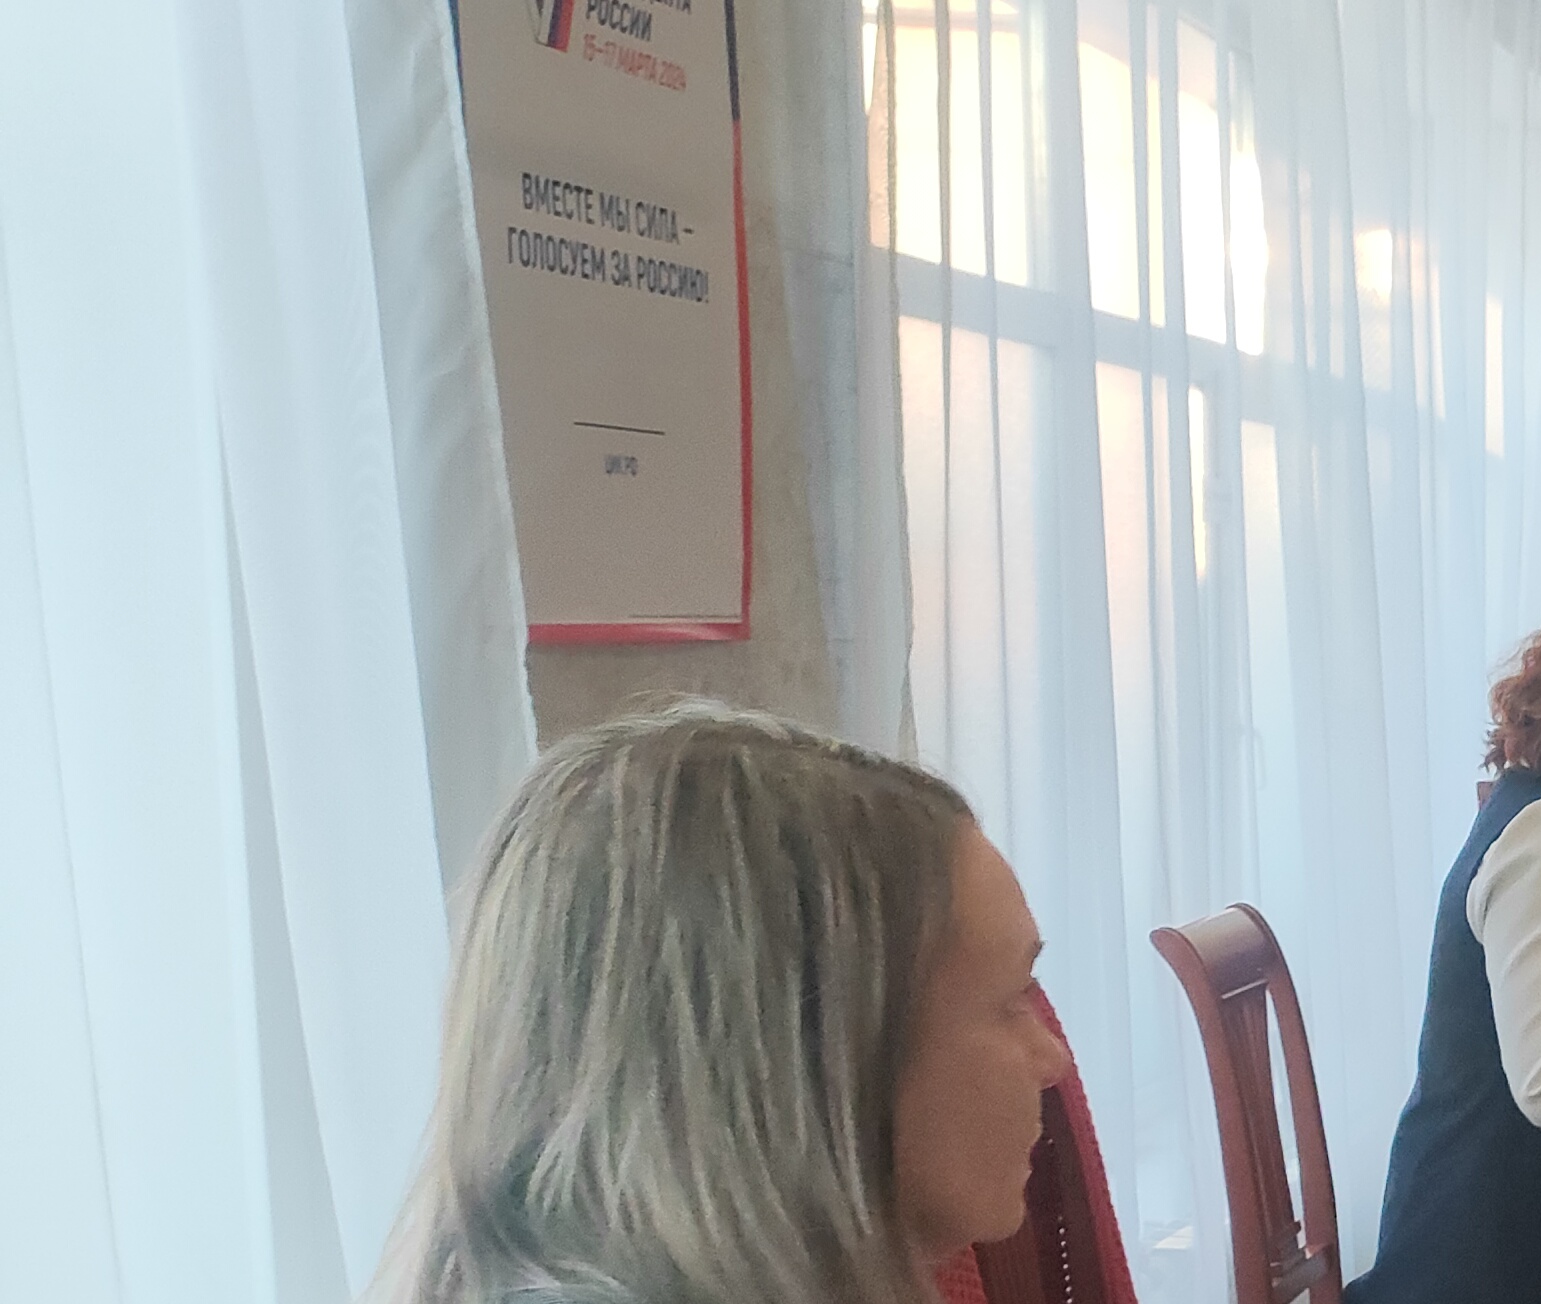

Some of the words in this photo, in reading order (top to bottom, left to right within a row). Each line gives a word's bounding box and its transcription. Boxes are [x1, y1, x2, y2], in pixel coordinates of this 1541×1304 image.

[521, 171, 595, 225] ВМЕСТЕ
[600, 190, 631, 234] МЫ
[635, 200, 680, 245] СИЛА
[507, 226, 606, 283] ГОЛОСУЕМ
[610, 248, 633, 287] ЗА
[636, 255, 710, 303] РОССИЮ!
